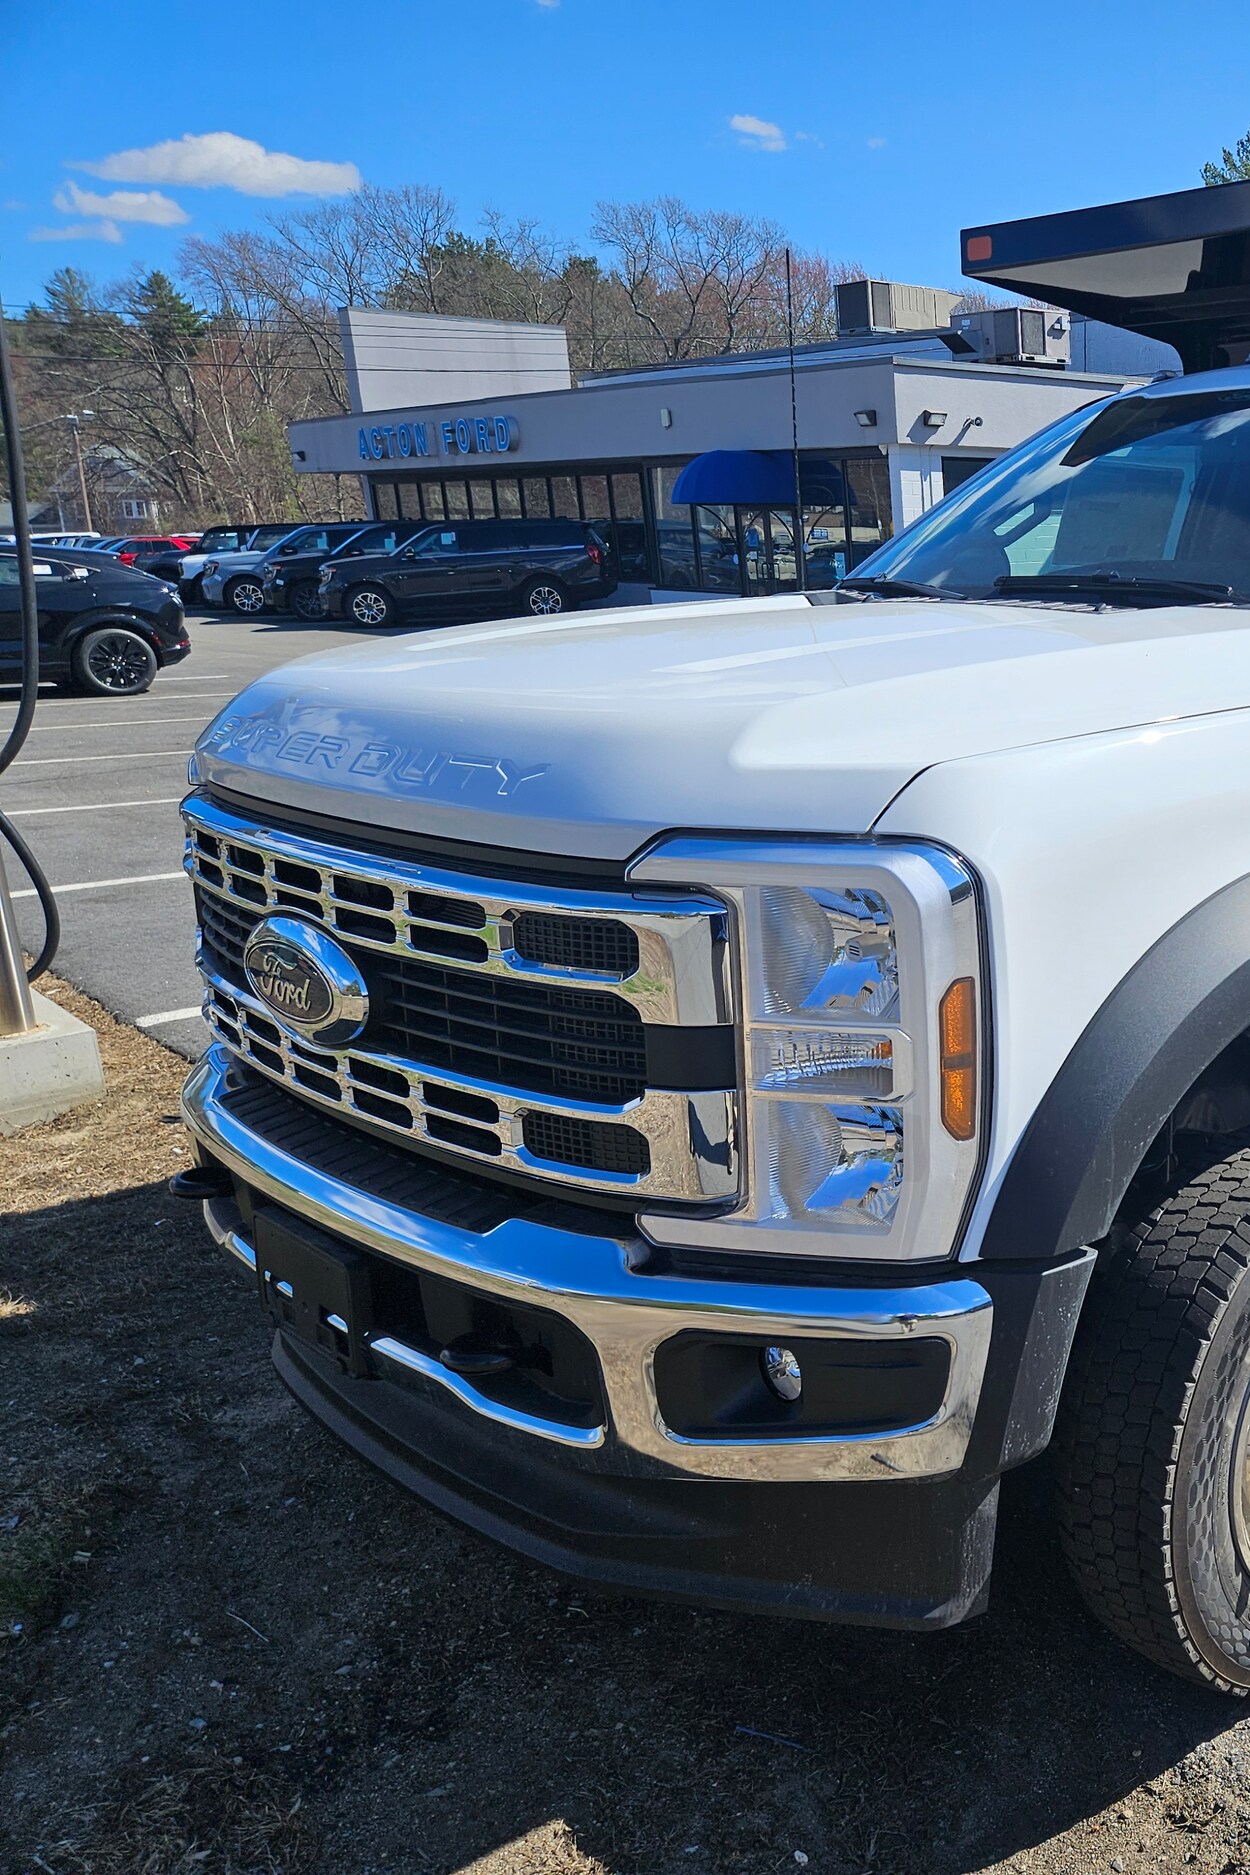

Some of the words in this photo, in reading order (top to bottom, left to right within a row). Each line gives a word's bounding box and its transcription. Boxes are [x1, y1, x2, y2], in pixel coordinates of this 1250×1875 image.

[358, 422, 428, 460] ACTON
[440, 415, 511, 455] FORD
[206, 715, 351, 770] SUPER
[348, 740, 552, 796] DUTY
[263, 951, 312, 1012] Ford
